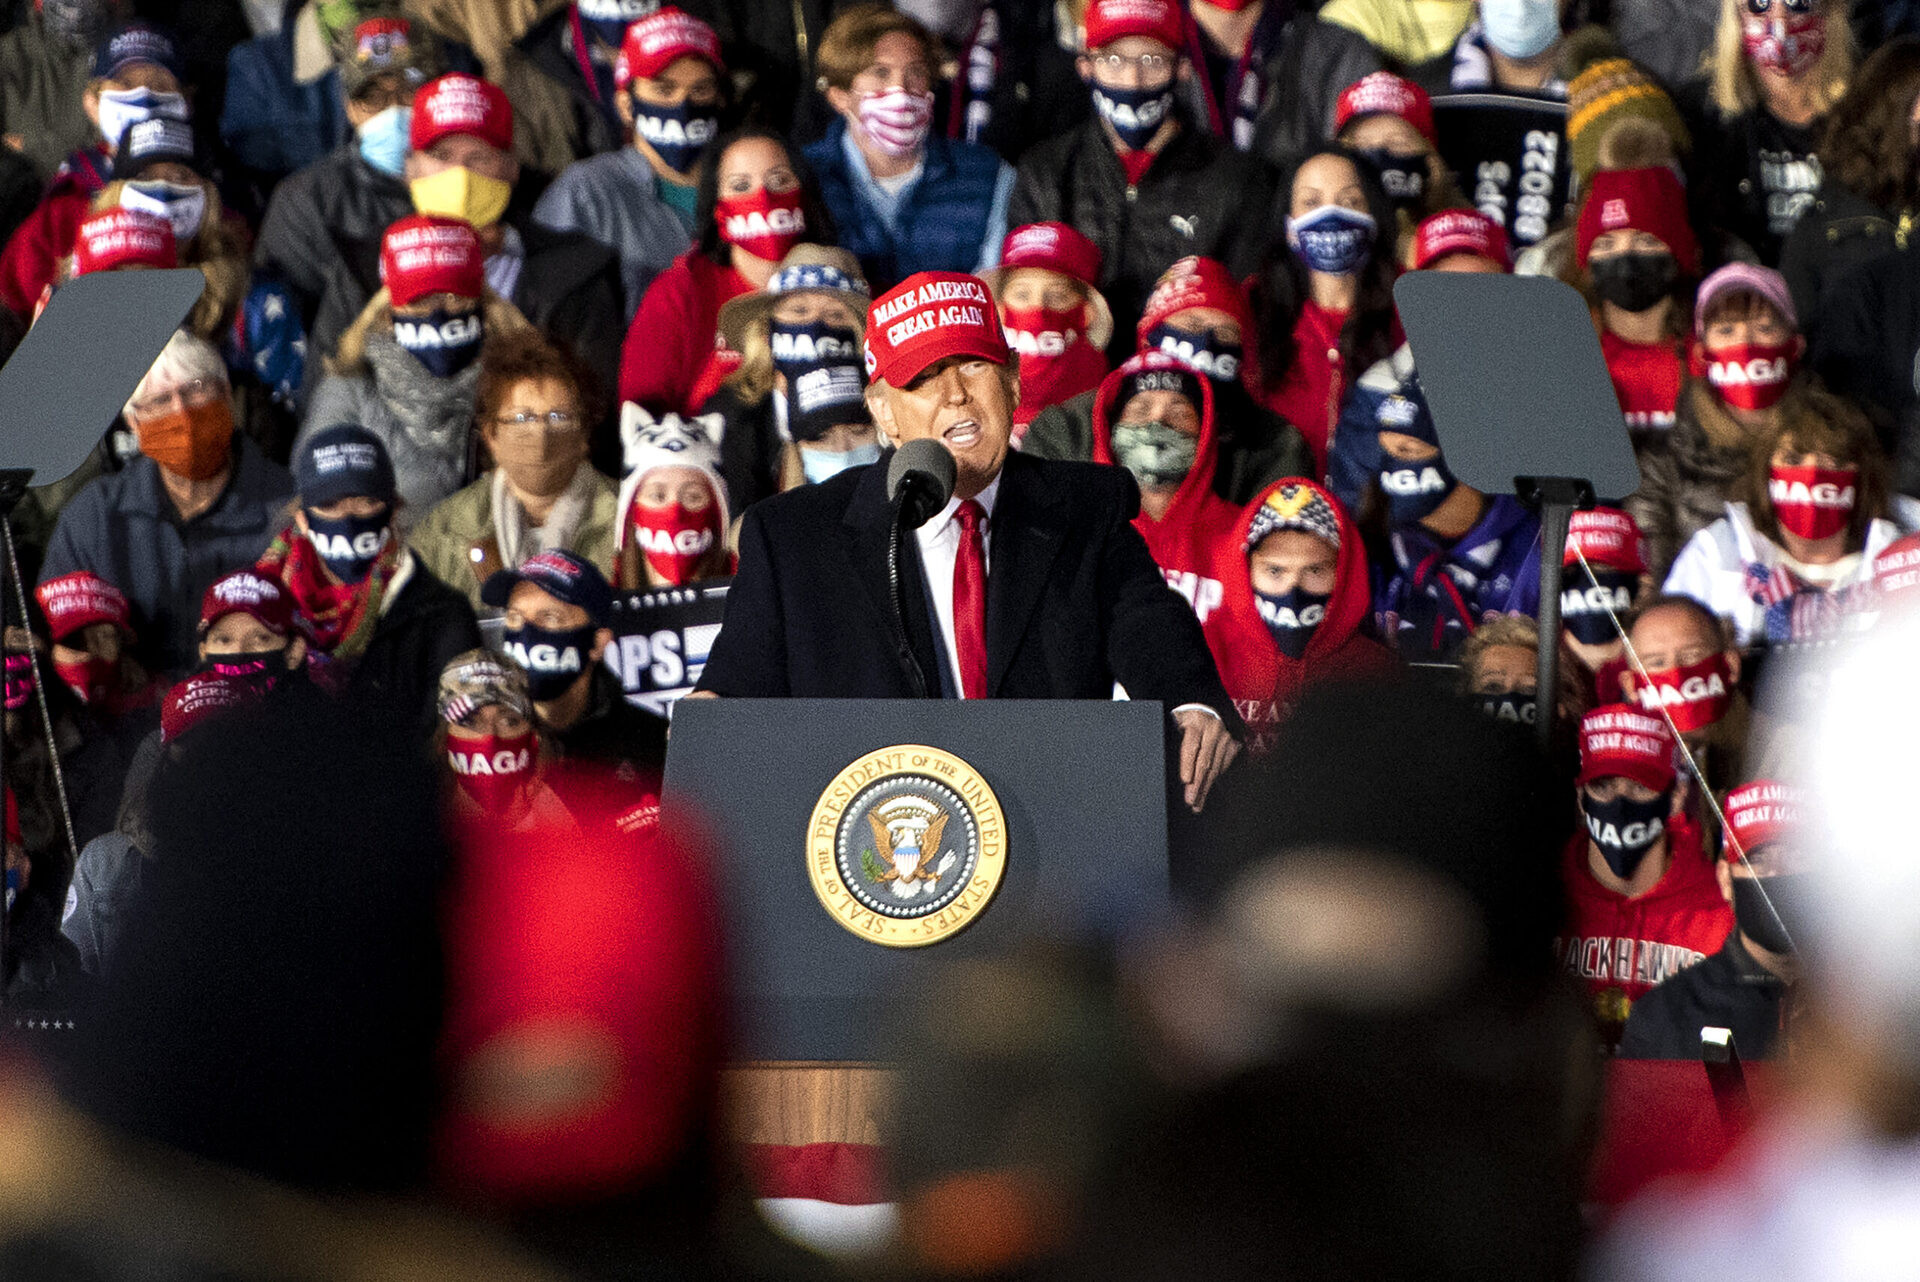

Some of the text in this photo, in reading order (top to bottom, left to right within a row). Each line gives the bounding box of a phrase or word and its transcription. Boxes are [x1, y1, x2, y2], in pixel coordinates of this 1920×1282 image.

[873, 281, 987, 328] MAKE AMERICA
[887, 305, 985, 347] GREAT AGAIN
[394, 315, 482, 349] MAGA
[815, 753, 1000, 935] SEAL OF THE PRESIDENT OF THE UNITED STATES
